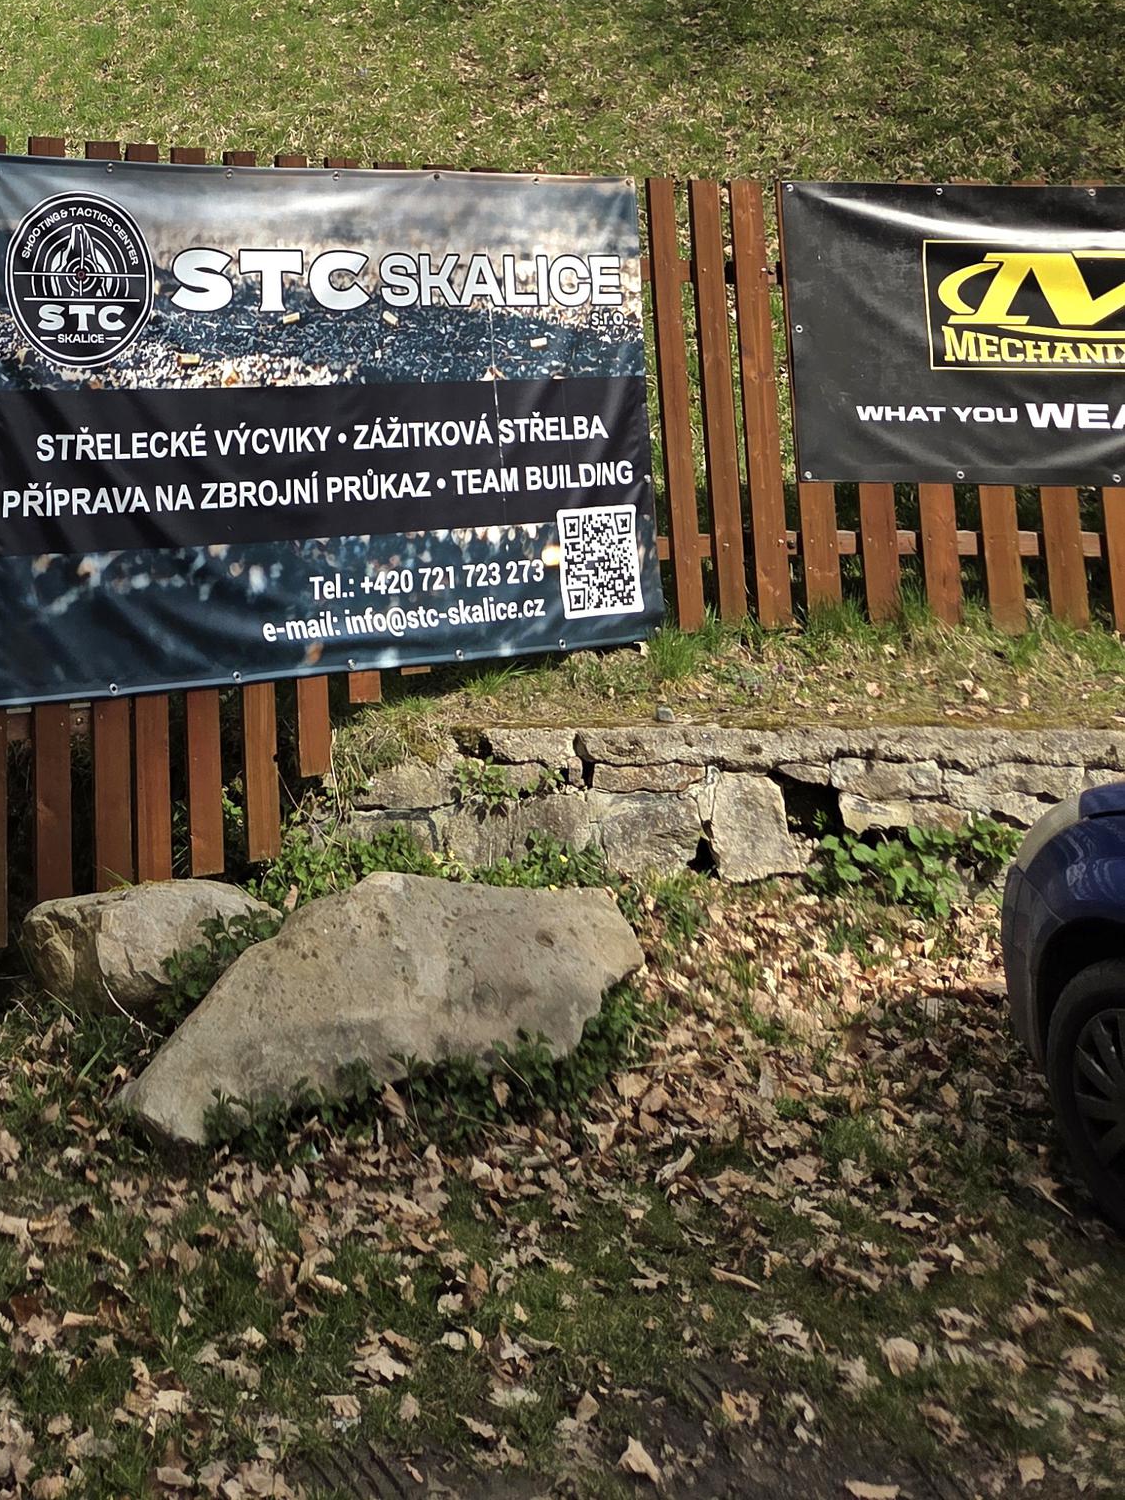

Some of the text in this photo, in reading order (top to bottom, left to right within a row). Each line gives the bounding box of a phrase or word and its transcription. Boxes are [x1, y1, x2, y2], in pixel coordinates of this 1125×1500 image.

[21, 213, 61, 259] SHOOTING
[68, 207, 114, 228] TACTICS
[112, 223, 139, 266] CENTER
[170, 247, 623, 313] STC SKALICE
[37, 303, 126, 332] STC
[57, 334, 105, 344] SKALICE
[590, 311, 629, 326] s.r.o.
[36, 411, 609, 462] STŘELECKÉ VÝCVIKY ZÁŽITKOVÁ STŘELBA
[856, 405, 946, 423] WHAT
[952, 406, 1018, 424] YOU
[2, 460, 634, 518] PŘÍPRAVA NA ZBROJNÍ PRŮKAZ TEAM BUILDING
[309, 559, 545, 601] Tel.: +420 721 723 273
[262, 596, 546, 642] e-mail: info@stc-skalice.cz
